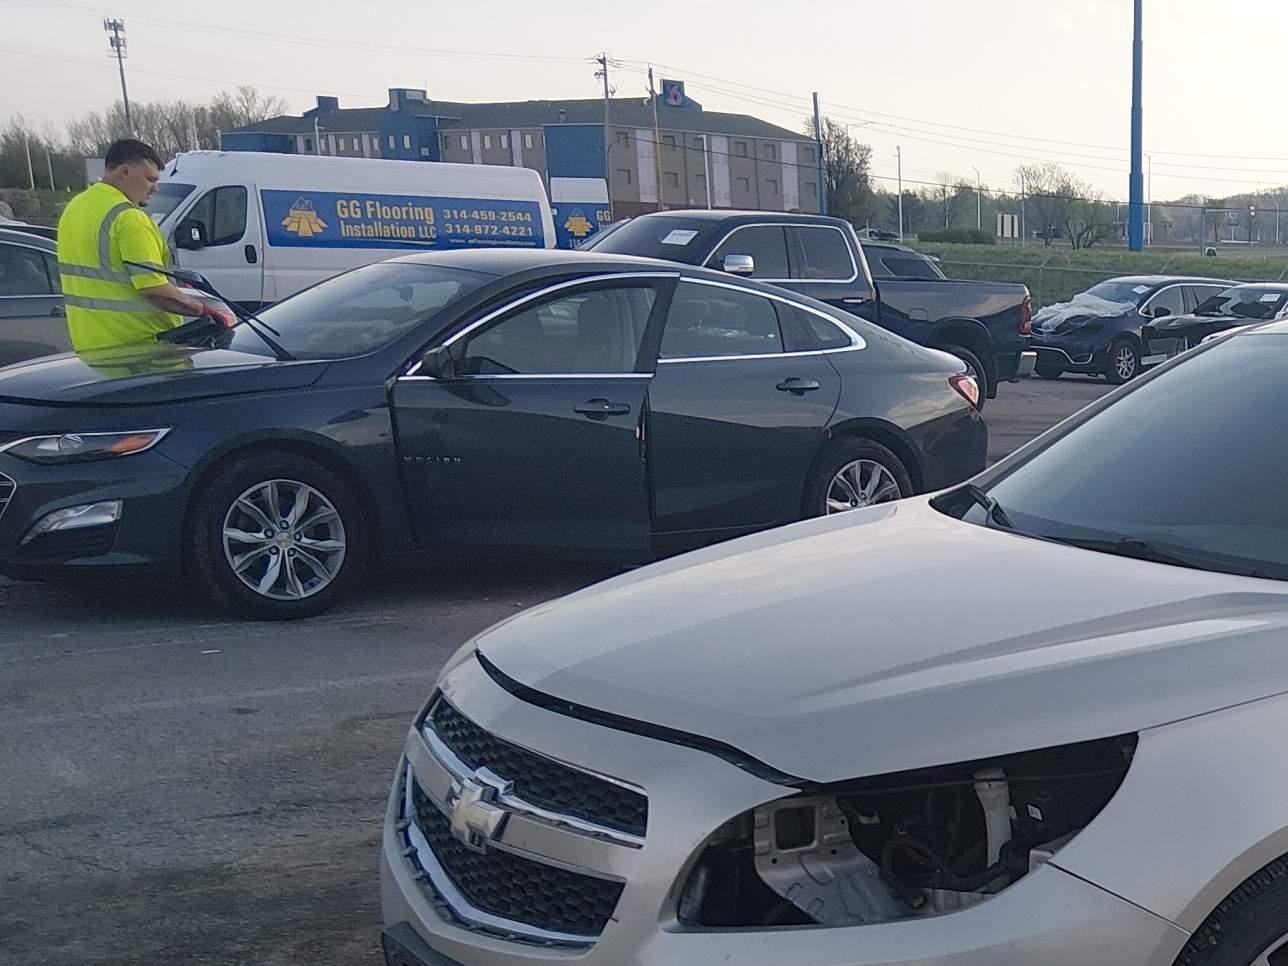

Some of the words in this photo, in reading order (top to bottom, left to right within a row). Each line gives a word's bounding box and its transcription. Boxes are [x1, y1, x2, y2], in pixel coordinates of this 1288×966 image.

[336, 199, 361, 219] GG
[366, 200, 435, 225] Flooring
[443, 208, 532, 222] 314-459-2544
[340, 221, 415, 239] Installation
[418, 225, 437, 239] LLC
